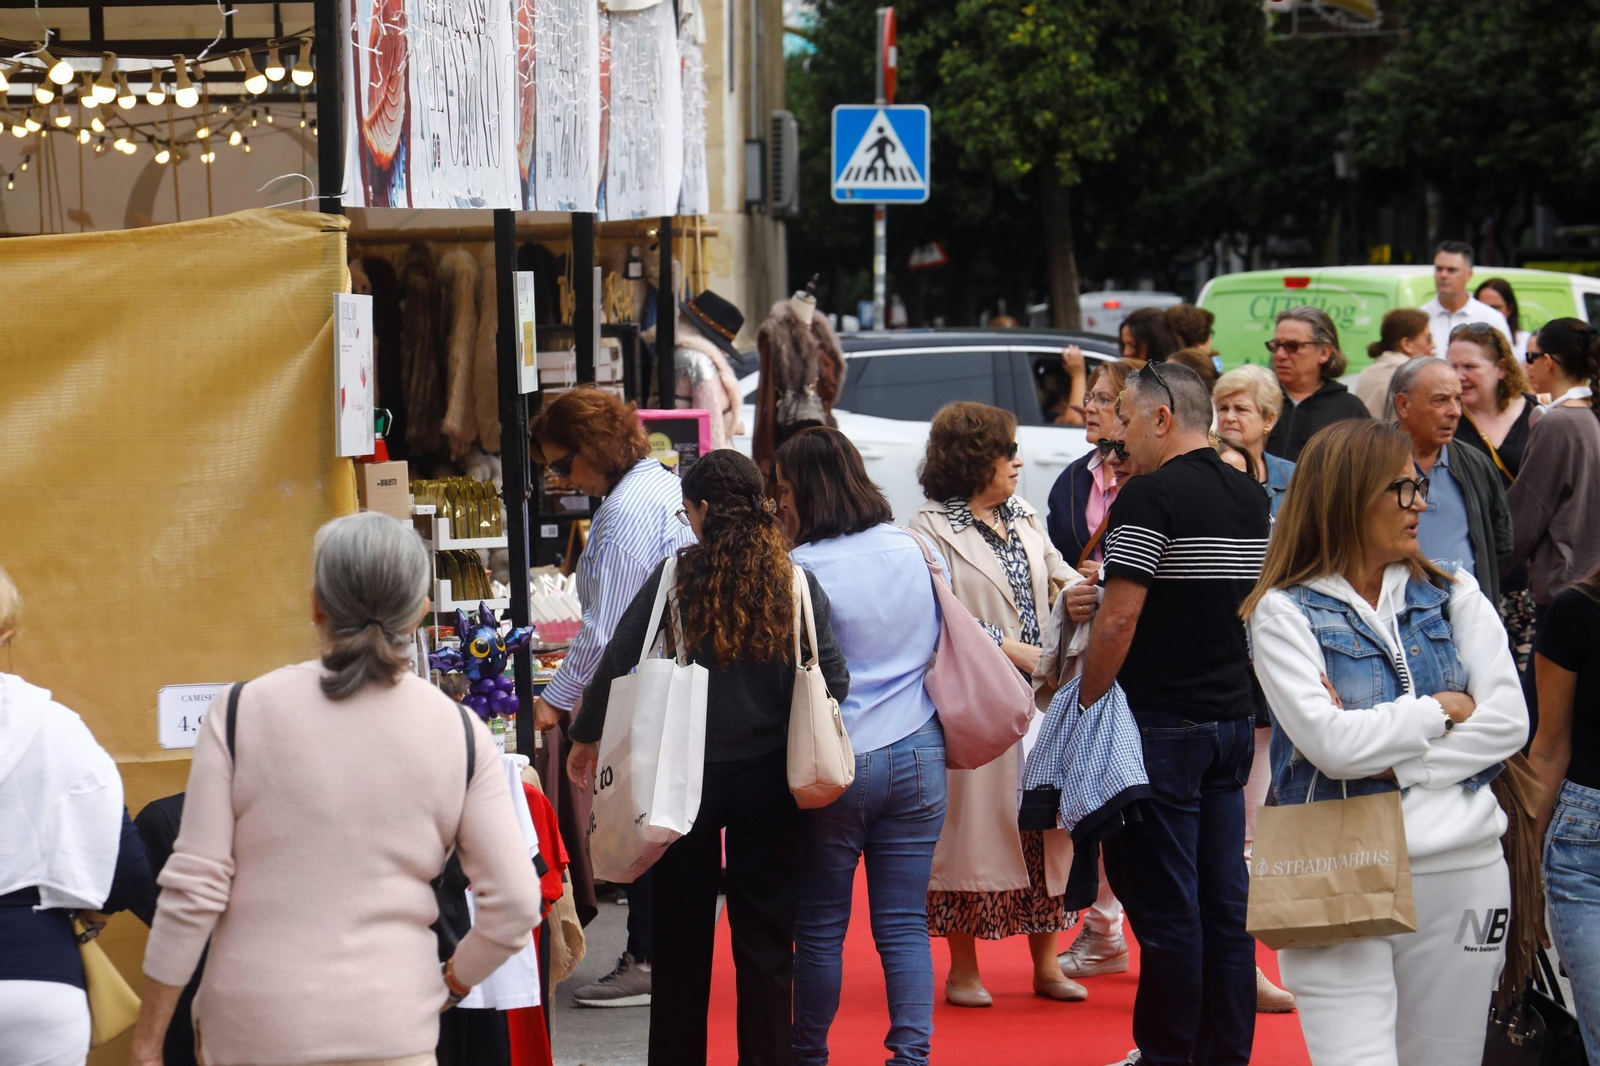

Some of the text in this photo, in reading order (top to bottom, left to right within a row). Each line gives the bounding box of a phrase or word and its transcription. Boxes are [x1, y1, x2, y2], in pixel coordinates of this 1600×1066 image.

[181, 693, 217, 702] CAMISE
[600, 765, 613, 791] to
[1272, 850, 1390, 876] STRADIVARIUS
[1453, 907, 1509, 945] NB
